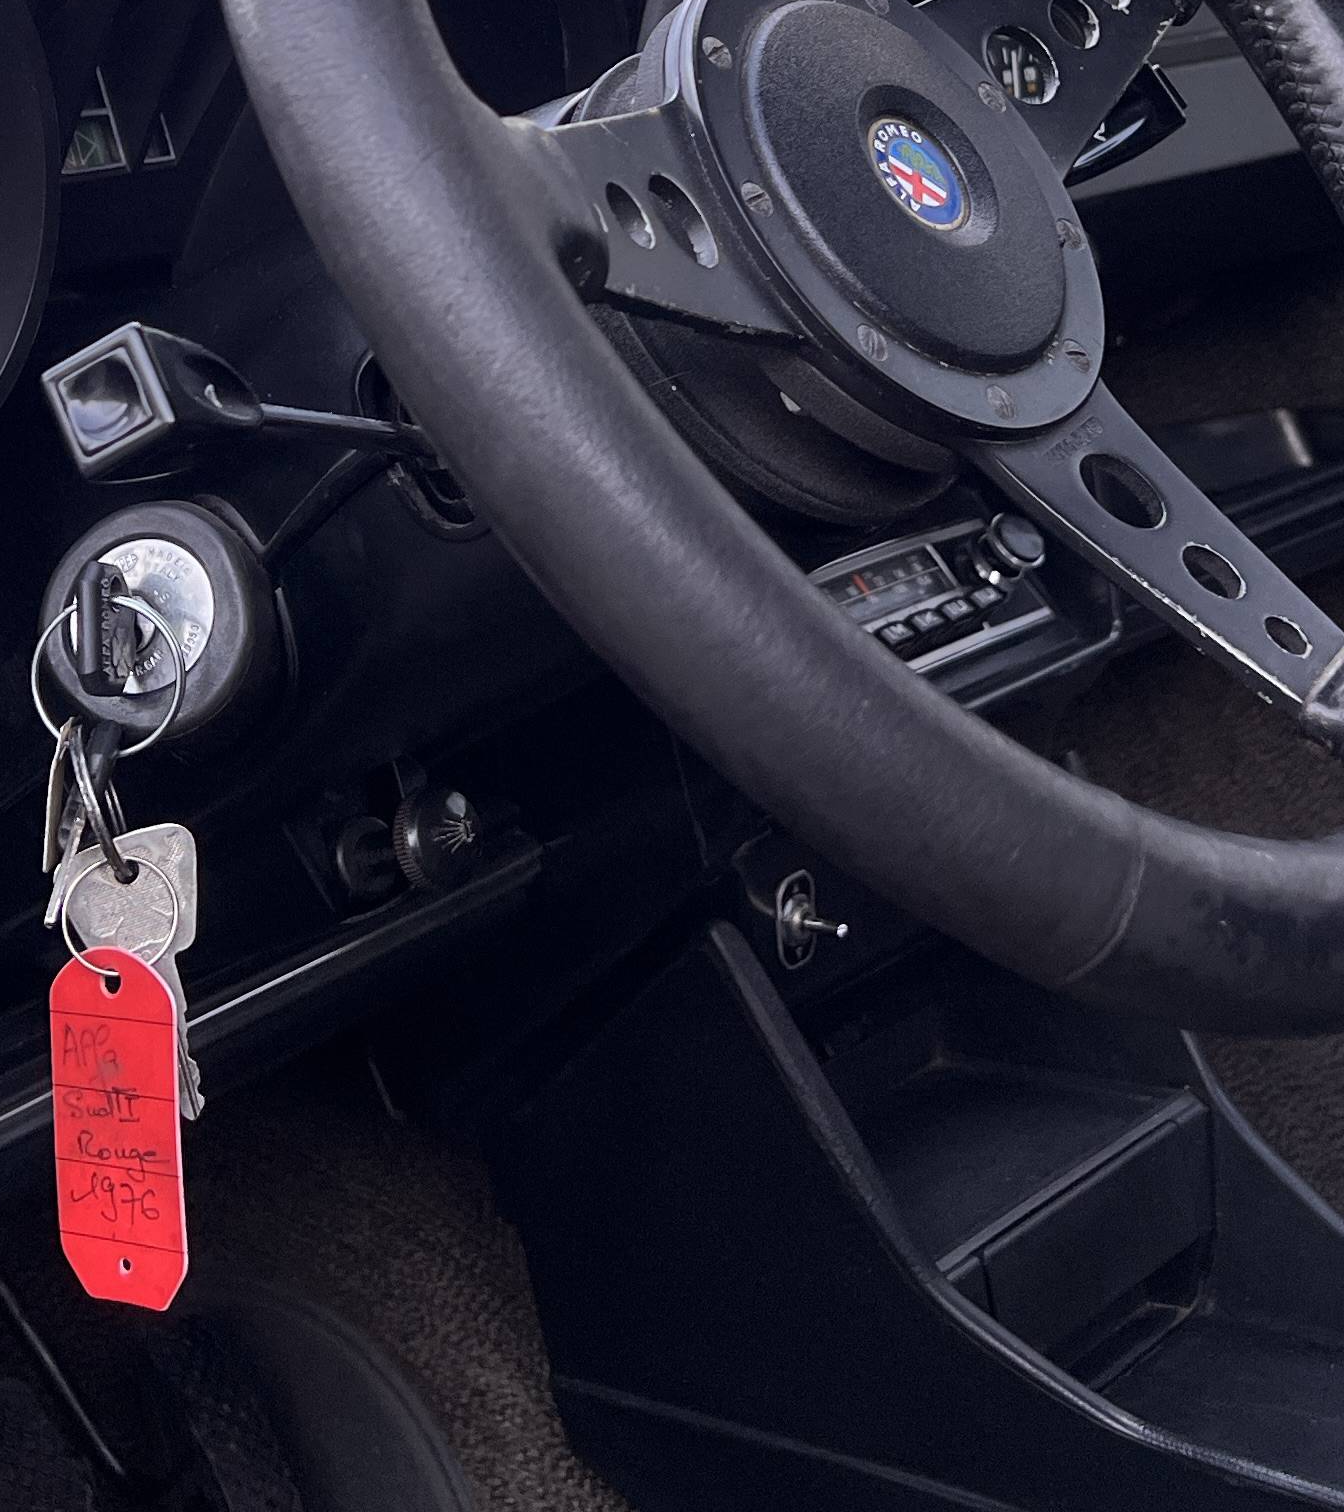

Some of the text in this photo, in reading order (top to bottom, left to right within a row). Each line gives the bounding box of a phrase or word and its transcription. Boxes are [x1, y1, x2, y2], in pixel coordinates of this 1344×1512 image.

[873, 123, 923, 212] ALFA ROMEO
[76, 1129, 170, 1182] Rouge
[70, 1172, 160, 1226] 1976
